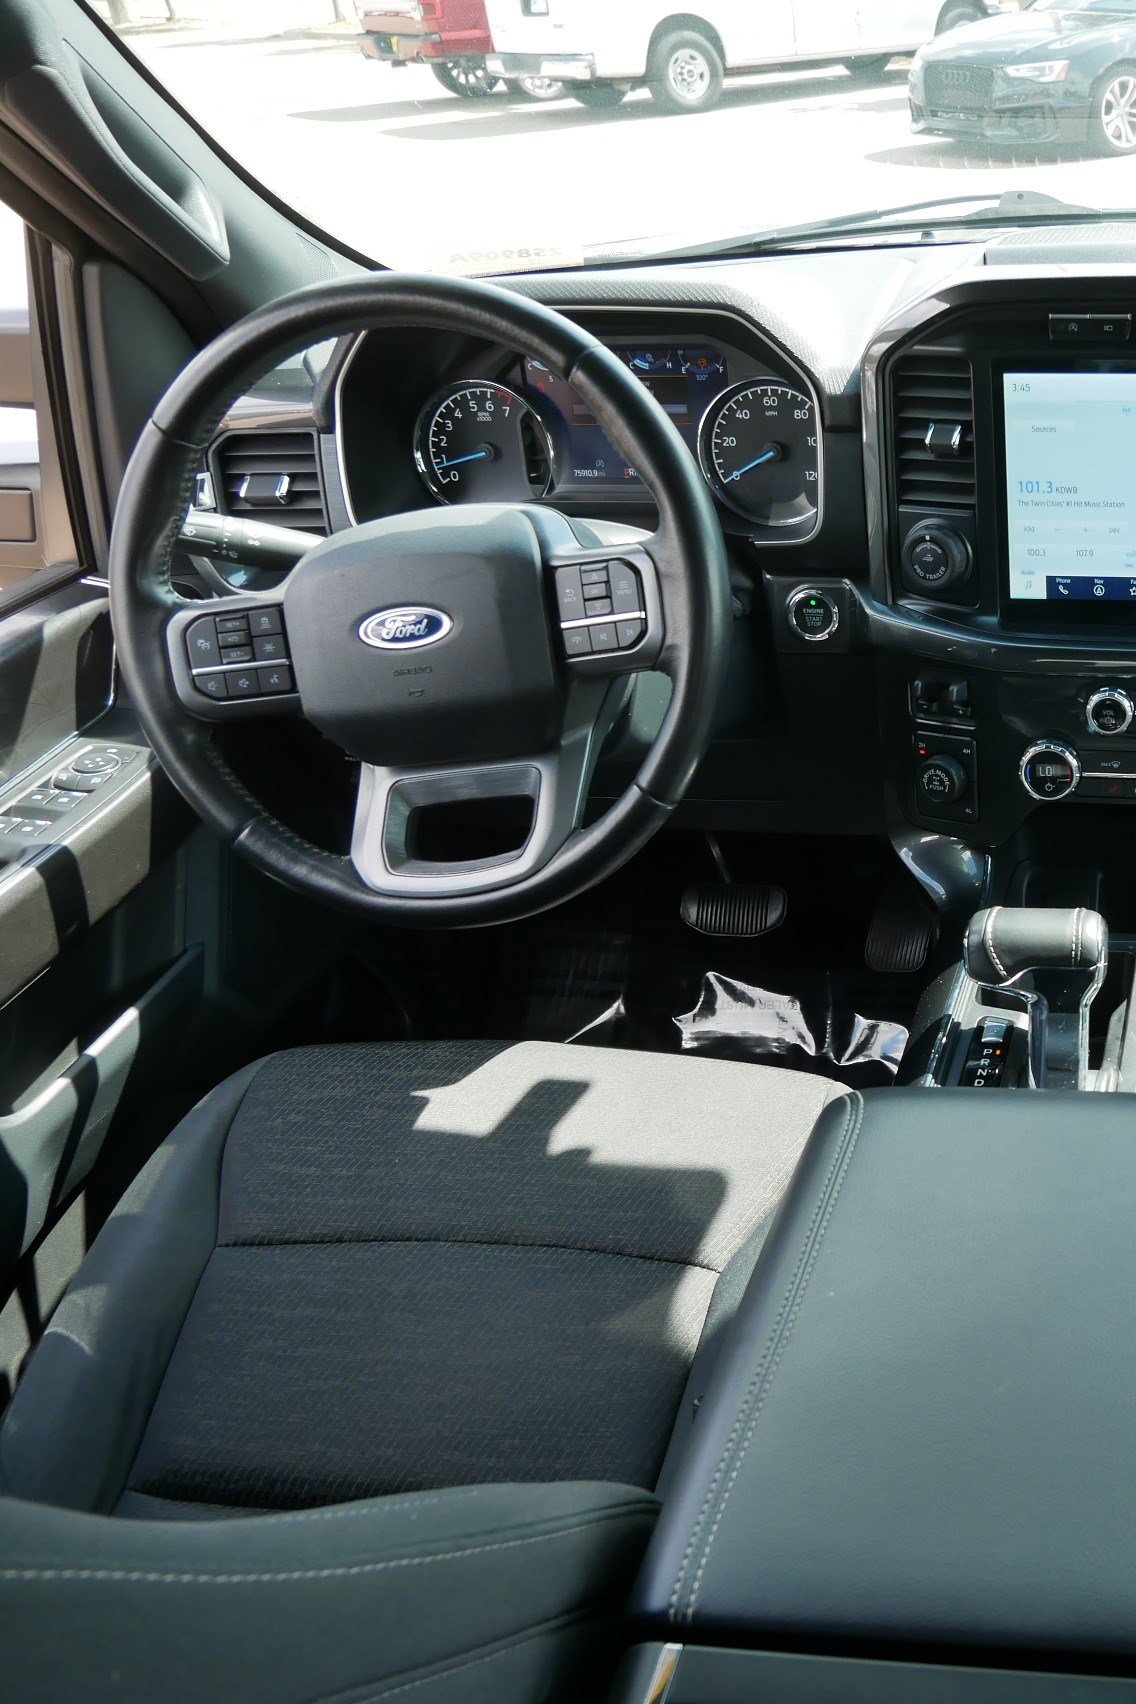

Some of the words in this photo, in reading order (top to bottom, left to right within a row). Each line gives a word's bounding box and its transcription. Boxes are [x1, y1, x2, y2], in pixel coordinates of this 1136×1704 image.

[1012, 383, 1031, 392] 3:45
[469, 401, 478, 412] 5
[485, 401, 495, 412] 6
[763, 396, 778, 407] 60
[454, 408, 463, 419] 4
[502, 406, 511, 418] 7
[735, 409, 750, 420] 40
[793, 409, 809, 420] 80
[444, 420, 453, 431] 3
[1031, 425, 1057, 433] Sources
[439, 436, 448, 447] 2
[722, 436, 737, 447] 20
[450, 471, 459, 481] 0
[732, 470, 741, 481] 0
[1018, 481, 1053, 494] 101.3
[1055, 486, 1078, 494] KDWB
[914, 565, 924, 577] PRO
[926, 566, 946, 580] TRAILER
[381, 615, 428, 640] Ford
[393, 666, 433, 677] AIRBAG
[923, 769, 935, 783] DRIVE
[936, 769, 950, 785] MODE
[980, 1058, 990, 1066] R
[974, 1079, 985, 1087] D
